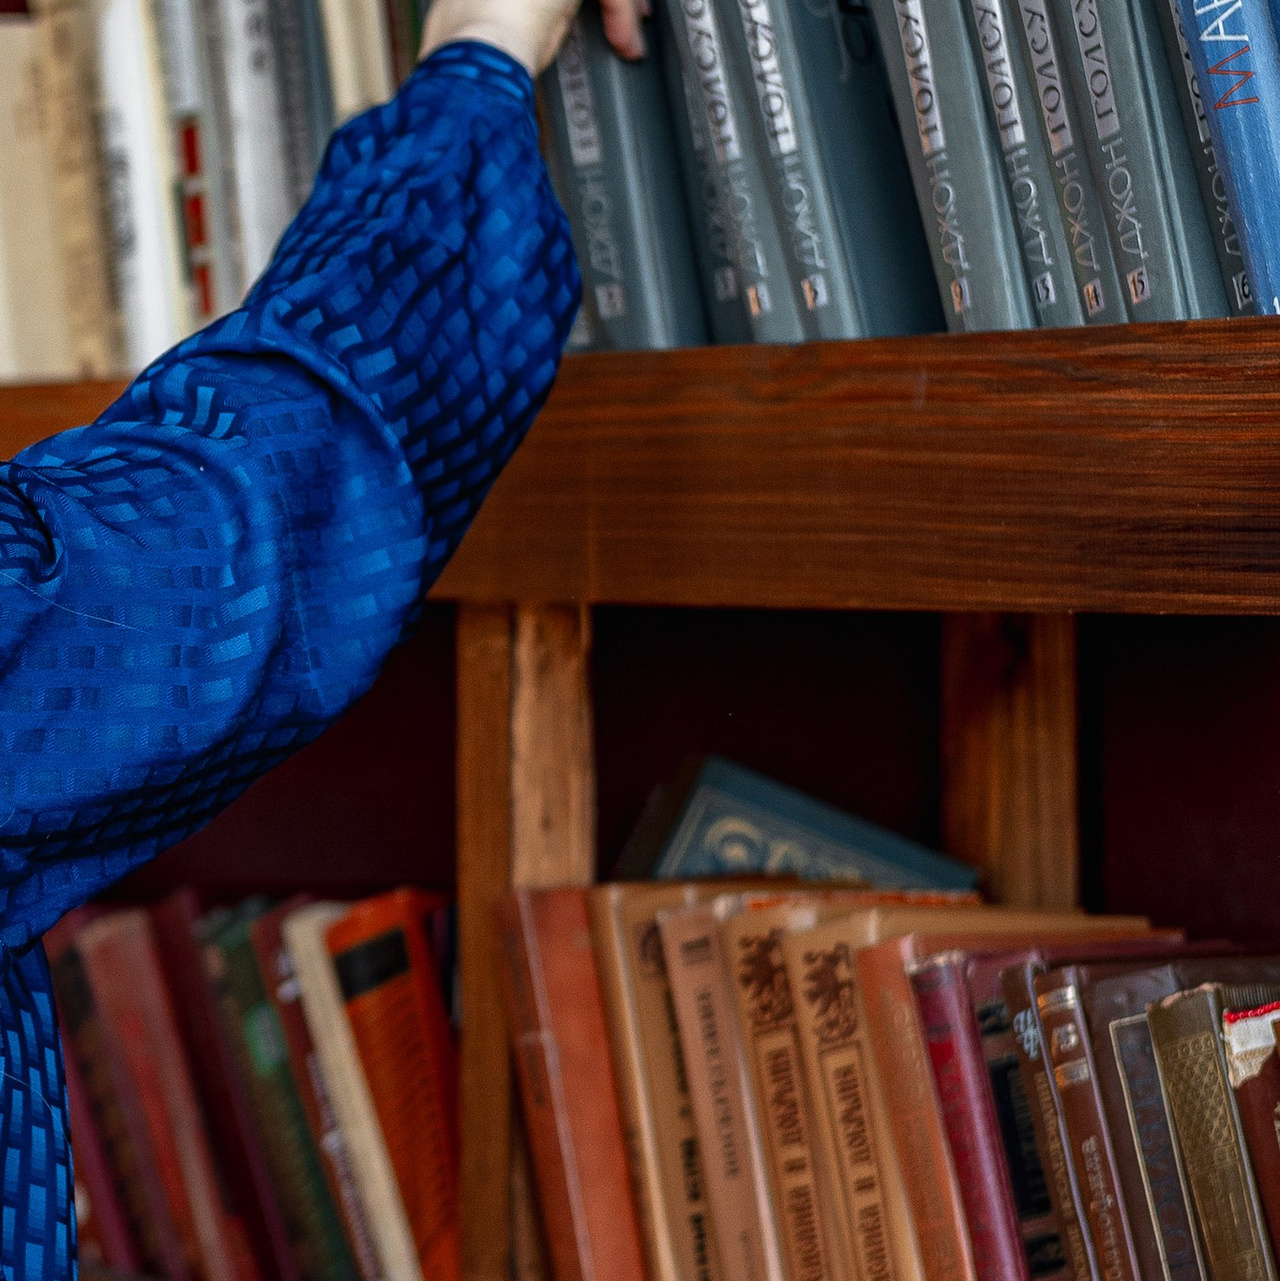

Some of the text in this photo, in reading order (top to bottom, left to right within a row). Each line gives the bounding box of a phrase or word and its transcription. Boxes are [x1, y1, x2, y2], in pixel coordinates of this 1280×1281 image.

[776, 154, 826, 267] ДЖОН
[926, 154, 969, 268] ДЖОН
[1003, 147, 1052, 264] ДЖОН
[1055, 154, 1099, 269] ДЖОН
[1102, 138, 1148, 258] ДЖОН
[1131, 275, 1147, 300] 15
